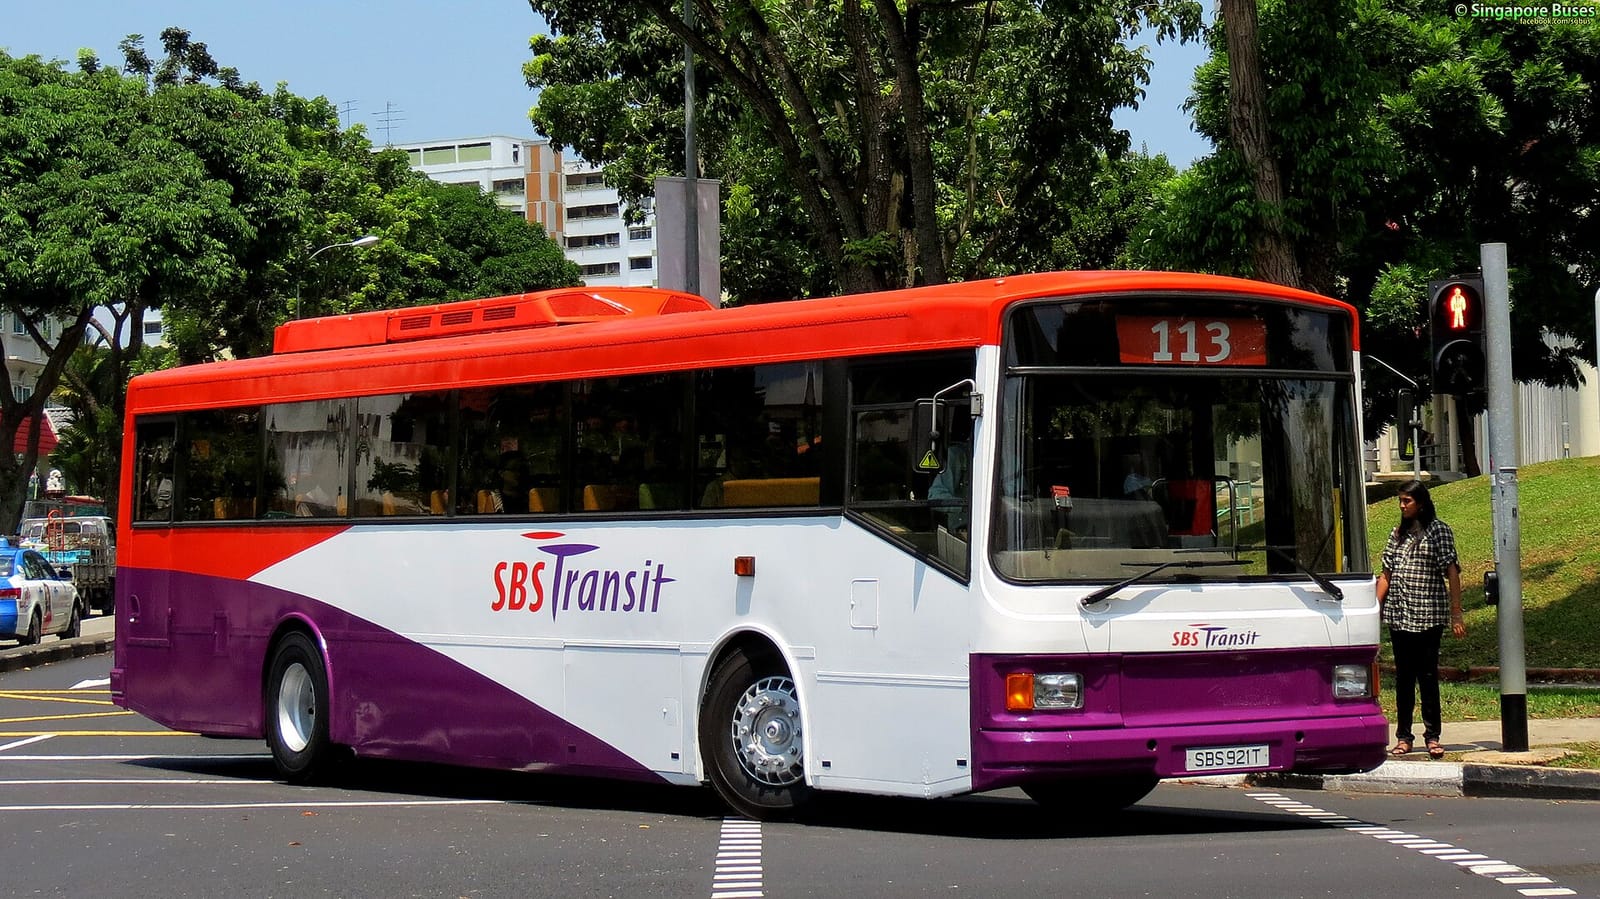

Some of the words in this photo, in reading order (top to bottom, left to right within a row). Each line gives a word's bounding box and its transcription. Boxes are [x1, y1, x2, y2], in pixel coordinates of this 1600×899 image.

[1151, 320, 1231, 363] 113
[491, 561, 546, 612] SBS
[537, 543, 678, 623] Transit
[1172, 631, 1199, 646] SBS
[1199, 627, 1261, 649] Transit
